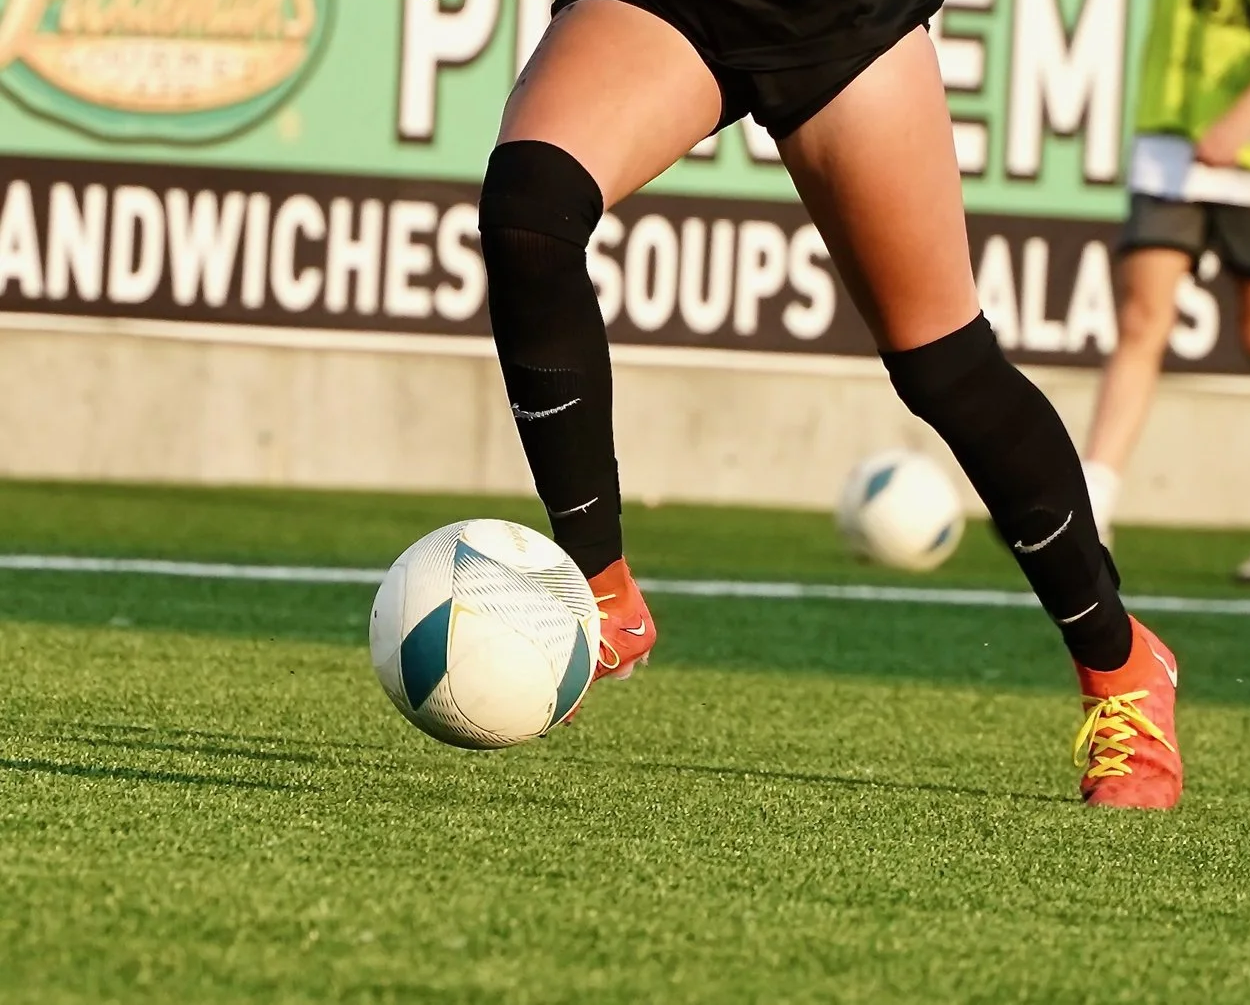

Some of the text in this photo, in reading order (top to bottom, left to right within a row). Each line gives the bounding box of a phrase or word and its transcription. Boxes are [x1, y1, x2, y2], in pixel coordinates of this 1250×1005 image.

[0, 179, 487, 323] ANDWICHES
[586, 210, 837, 340] SOUPS
[975, 235, 1221, 360] ALAS
